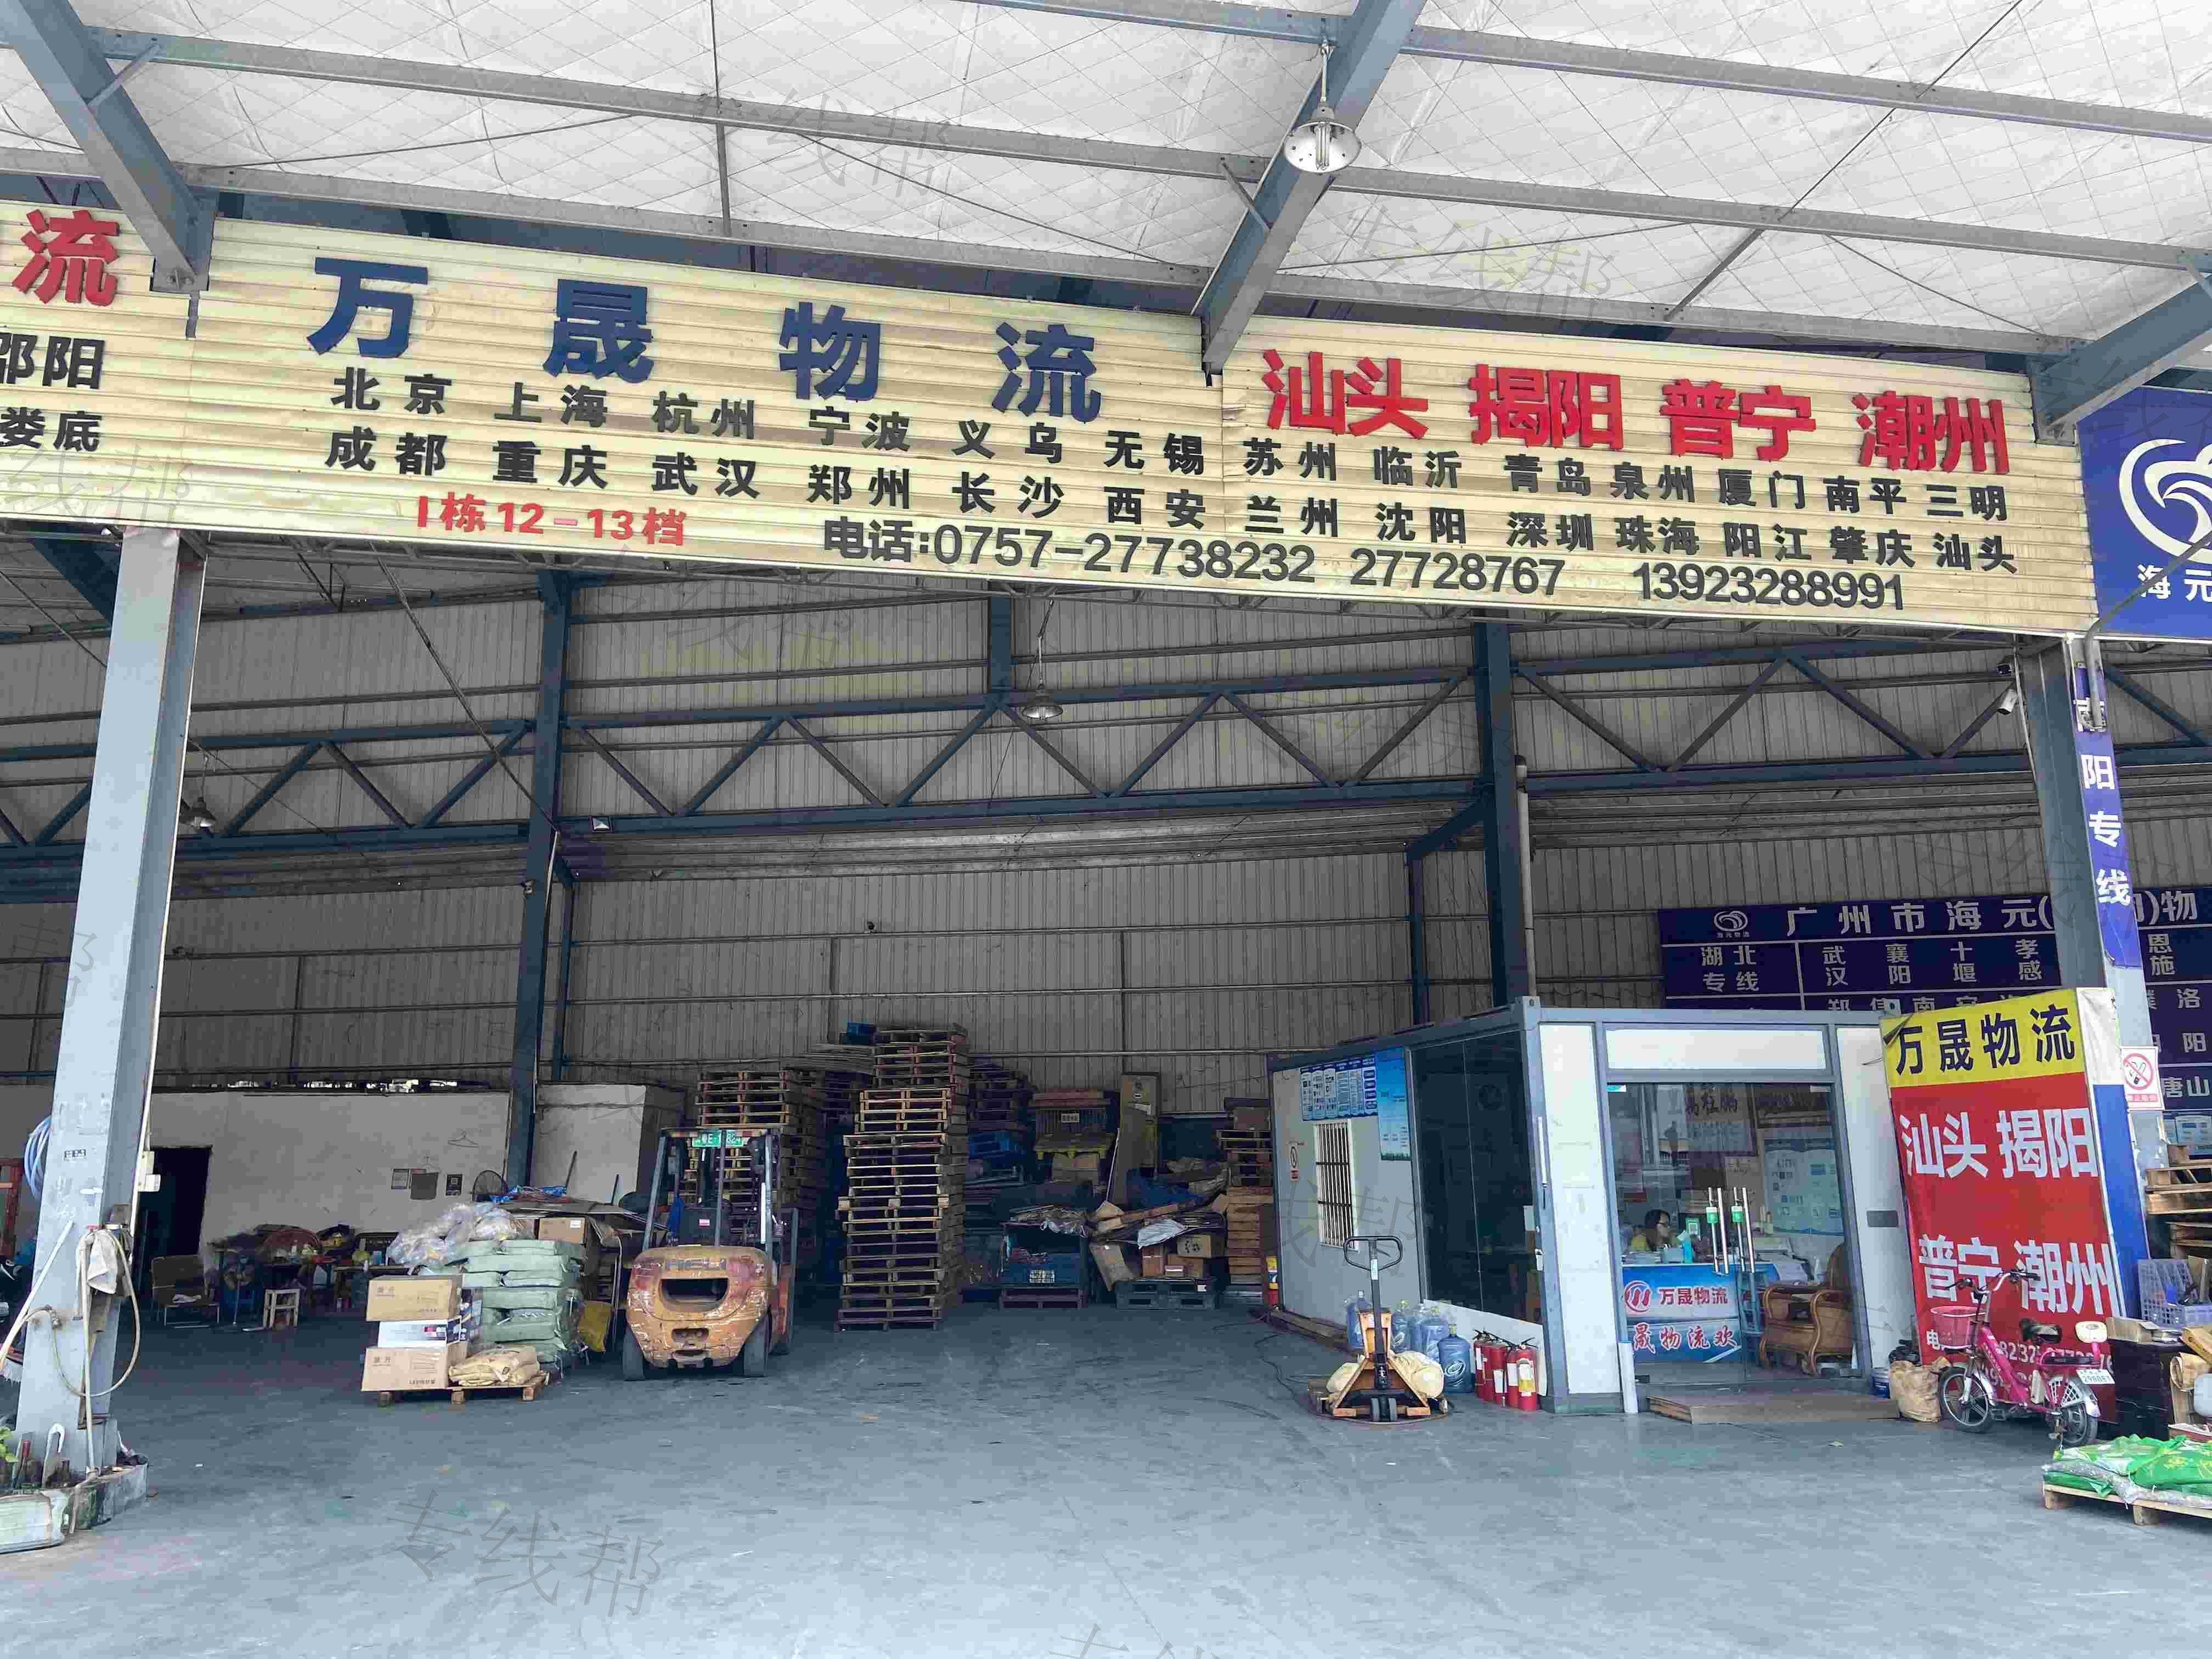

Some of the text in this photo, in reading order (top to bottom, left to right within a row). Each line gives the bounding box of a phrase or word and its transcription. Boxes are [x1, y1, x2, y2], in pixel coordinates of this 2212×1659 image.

[12, 210, 119, 307] 流
[306, 257, 1103, 424] 万晟物流
[0, 407, 102, 452] 娄底
[331, 367, 2007, 521] 北京 上海 杭州 宁波 义乌 无锡 苏州 临沂 青岛 泉州 厦门 南平 三明
[1264, 351, 2010, 474] 汕头 揭阳 普宁 潮州
[325, 426, 2017, 574] 成都 重庆 武汉 郑州 长沙 西安 兰州 沈阳 深圳 珠海 阳江 肇庆 汕头
[1351, 549, 1565, 595] 27728767
[1633, 561, 1904, 610] 13923288991
[1701, 945, 1757, 966] 湖北
[1703, 972, 1759, 992] 专线
[1895, 1004, 2075, 1076] 万晟物流
[1899, 1111, 1989, 1178] 汕头
[1996, 1108, 2099, 1178] 揭阳
[1658, 1286, 1728, 1305] 万晟物流
[1918, 1234, 2116, 1316] 普宁 潮州
